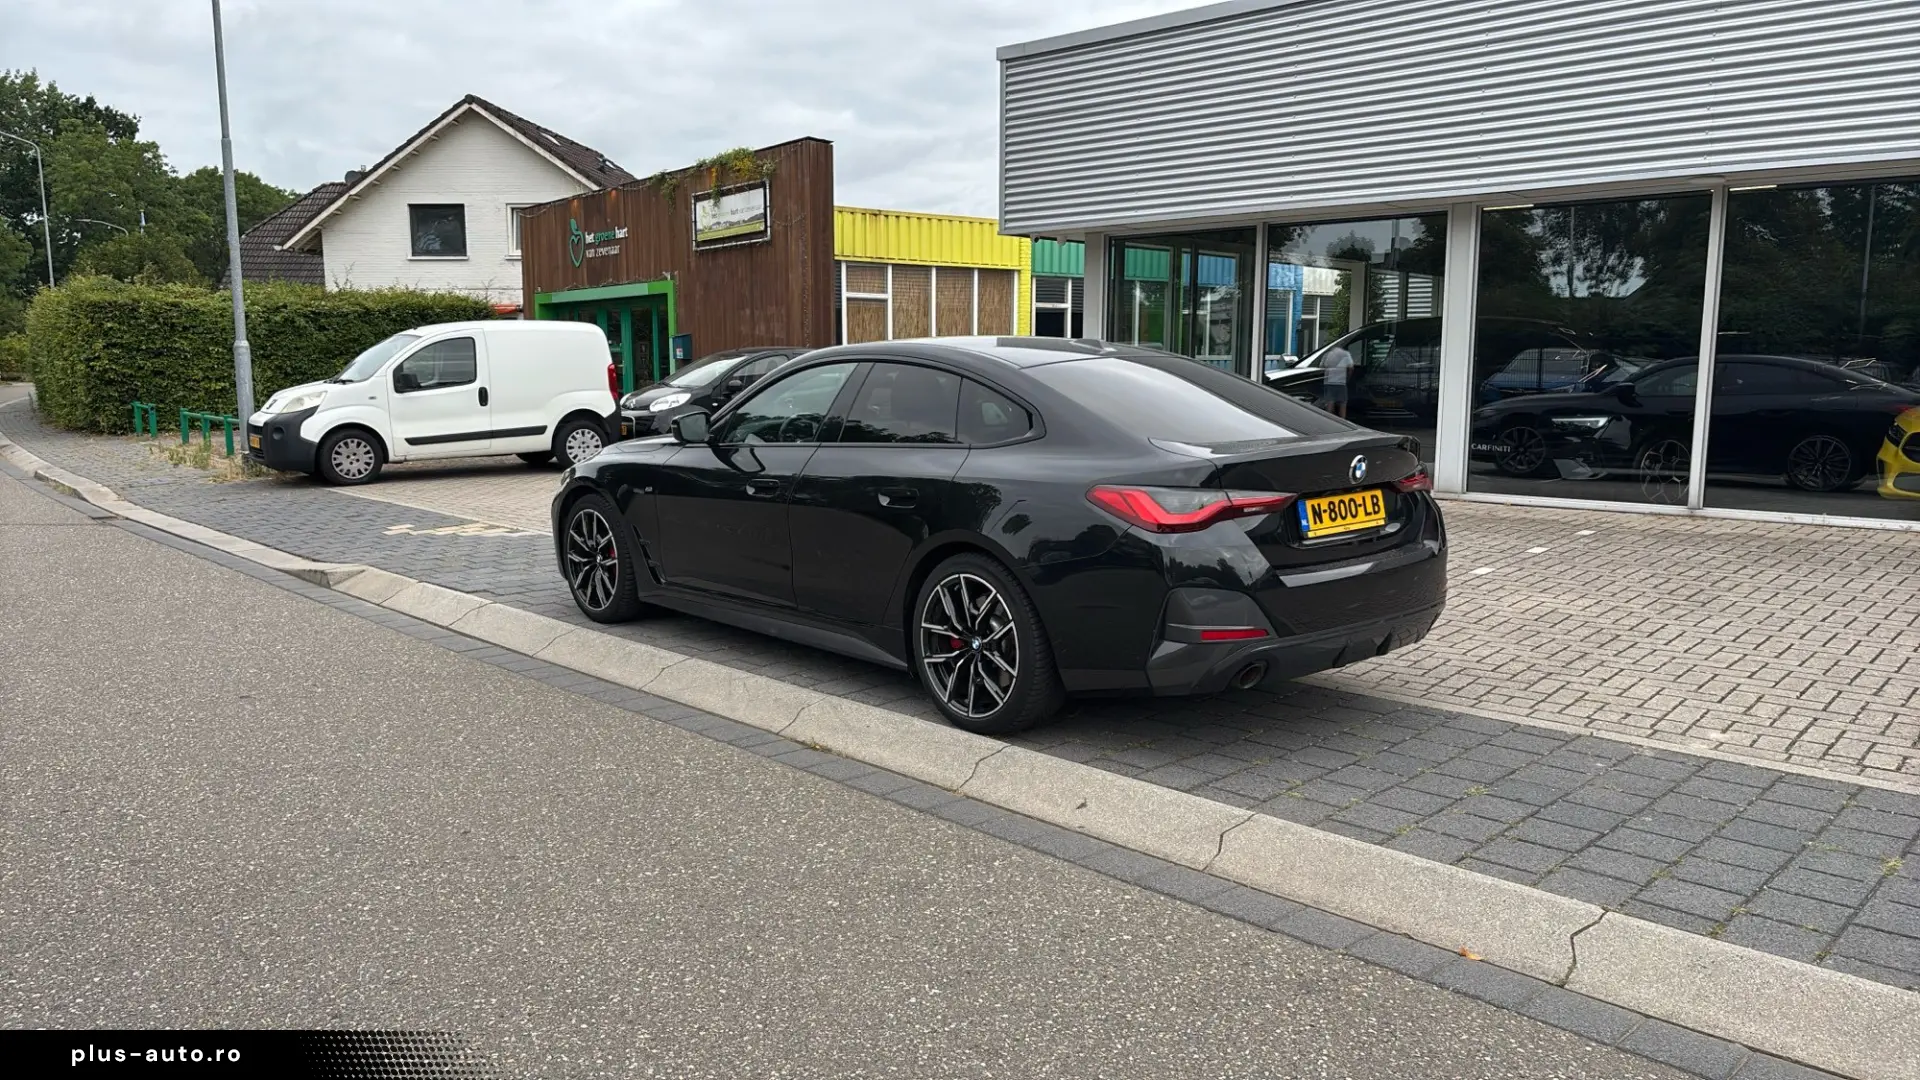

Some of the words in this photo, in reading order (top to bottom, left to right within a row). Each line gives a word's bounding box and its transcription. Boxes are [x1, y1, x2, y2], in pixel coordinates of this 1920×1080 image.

[585, 231, 595, 244] het
[595, 230, 615, 245] groene
[615, 226, 628, 239] hart
[585, 248, 595, 258] van
[596, 245, 620, 257] zevenaar
[1471, 443, 1511, 453] CARFINITI
[1311, 494, 1381, 525] N-800-LB
